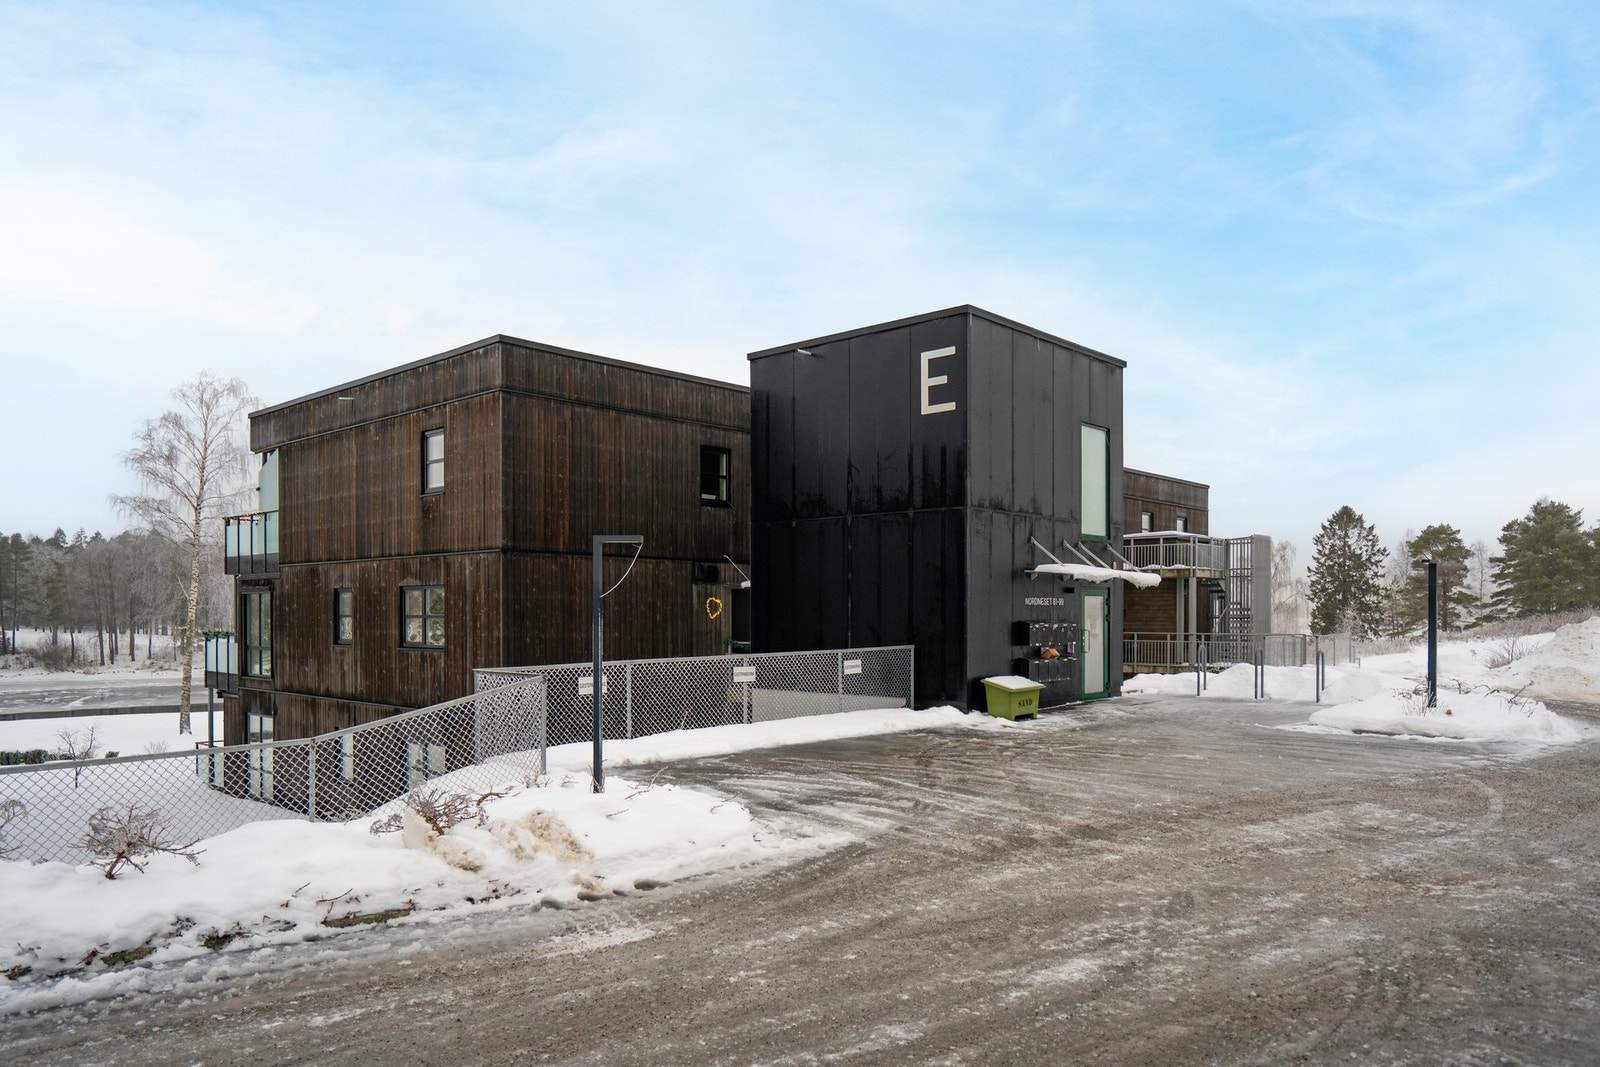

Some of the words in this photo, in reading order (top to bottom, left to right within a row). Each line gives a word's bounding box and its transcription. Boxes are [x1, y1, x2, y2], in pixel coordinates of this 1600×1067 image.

[920, 345, 956, 415] E
[1024, 597, 1052, 606] NORDNESET
[1017, 698, 1033, 709] SAND
